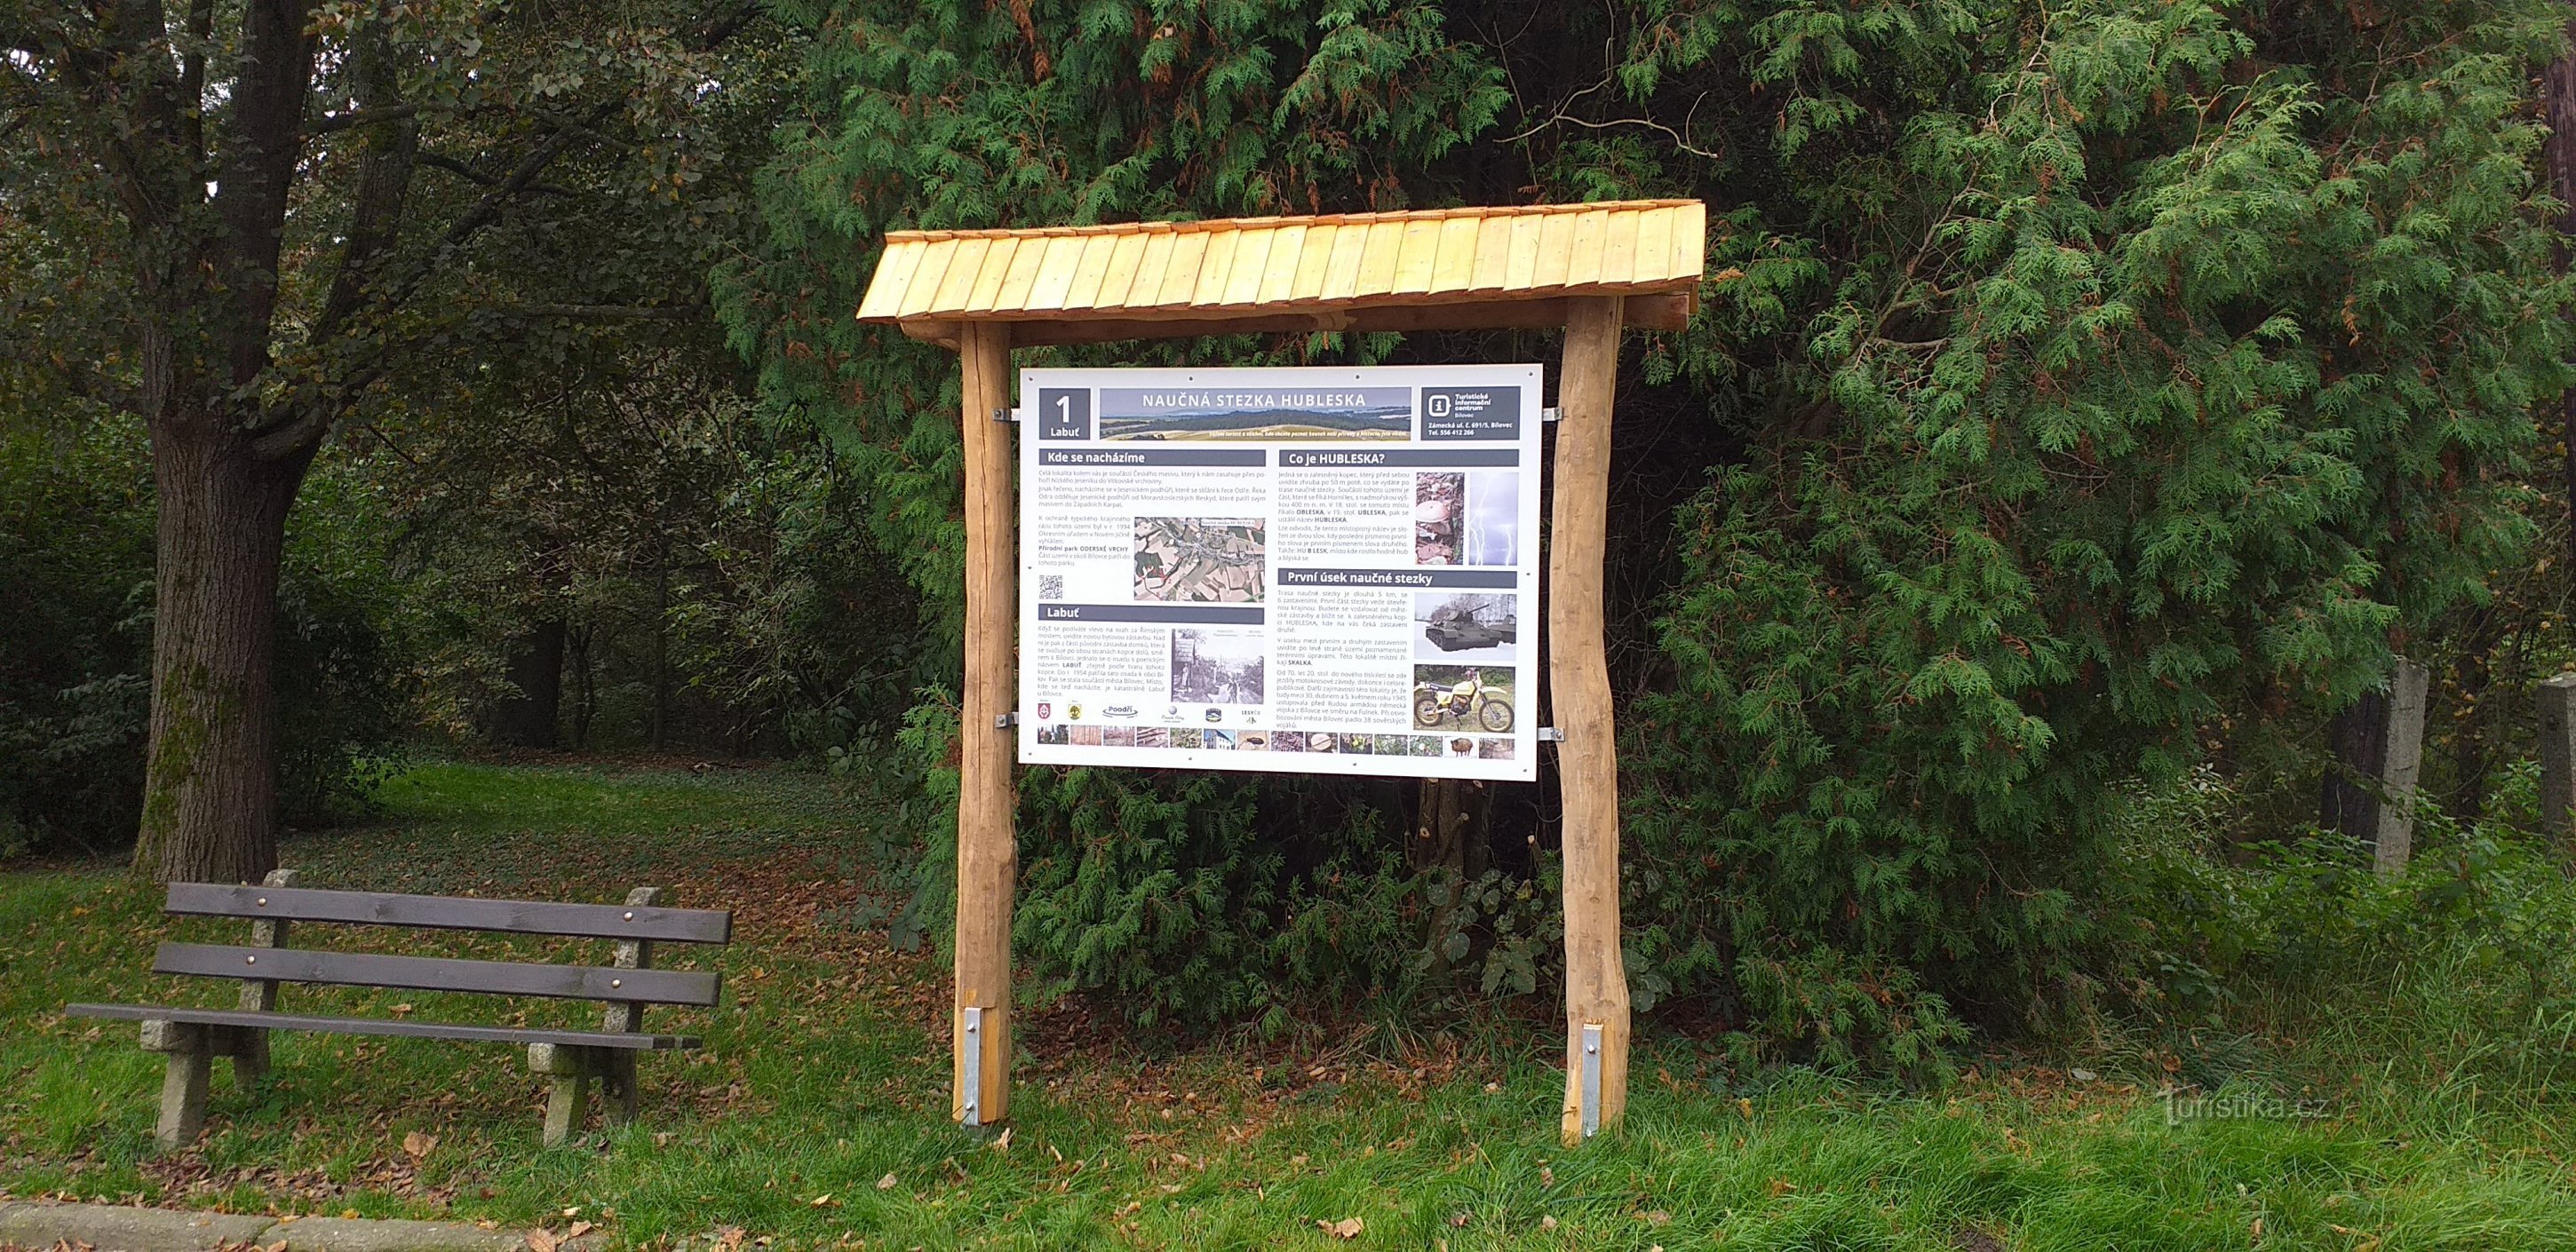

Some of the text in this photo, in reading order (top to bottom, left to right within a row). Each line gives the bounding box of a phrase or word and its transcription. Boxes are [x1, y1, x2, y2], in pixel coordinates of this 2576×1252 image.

[1142, 392, 1366, 407] NAUČNÁ STEZKA HUBLESKA
[1055, 395, 1069, 423] 1
[1050, 427, 1080, 437] Labuť
[1048, 452, 1069, 463] Kde
[1085, 452, 1145, 464] nacházíme
[1289, 454, 1385, 466] Co je HUBLESKA?
[1288, 572, 1433, 586] První úsek naučné stezky
[1046, 607, 1079, 618] Labuť
